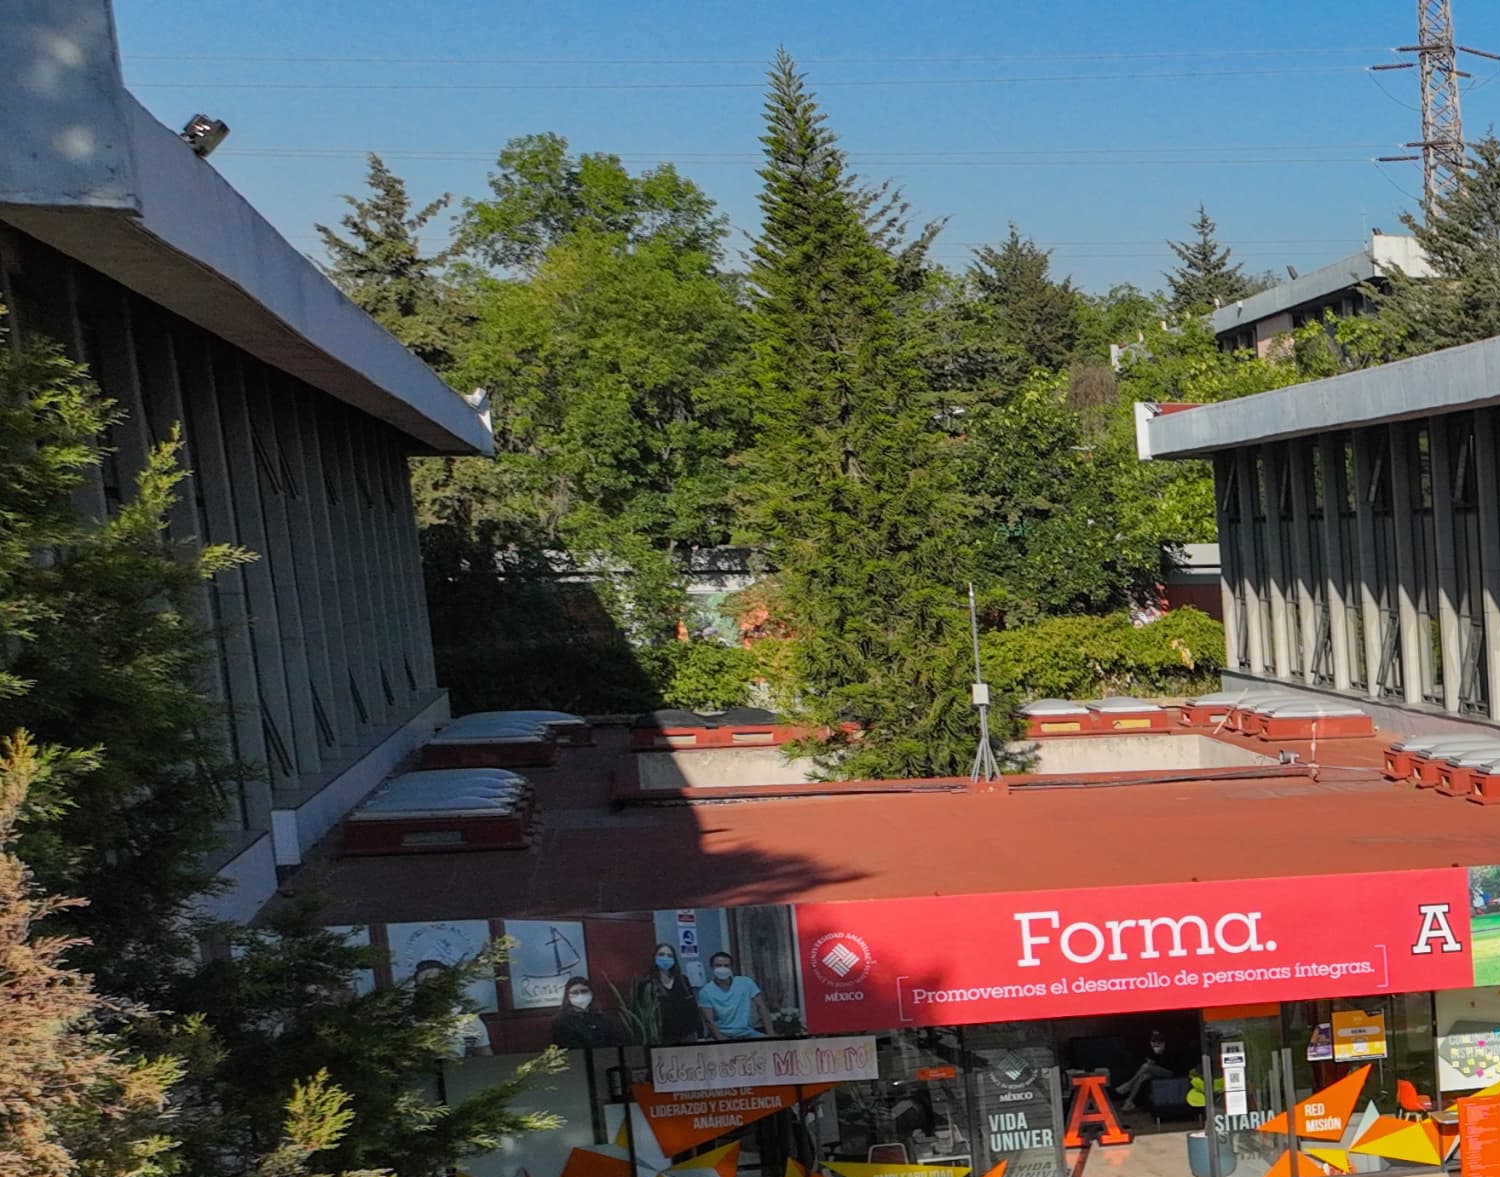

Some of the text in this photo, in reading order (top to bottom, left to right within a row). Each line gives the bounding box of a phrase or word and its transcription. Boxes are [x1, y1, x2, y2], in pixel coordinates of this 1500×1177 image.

[1013, 911, 1277, 967] Forma.
[1411, 902, 1463, 956] A
[912, 961, 1375, 1004] Promovemos el desarrollo de personas íntegras.
[824, 990, 864, 1002] MÉXICO
[650, 1096, 782, 1118] LIDERAZGO Y EXCELENCIA
[1000, 1091, 1033, 1102] MÉXICO
[1062, 1075, 1129, 1149] A
[1304, 1103, 1325, 1117] RED
[692, 1113, 744, 1129] ANÁHUAC
[988, 1112, 1028, 1132] VIDA
[1305, 1116, 1342, 1132] MISIÓN
[990, 1129, 1053, 1152] UNIVER
